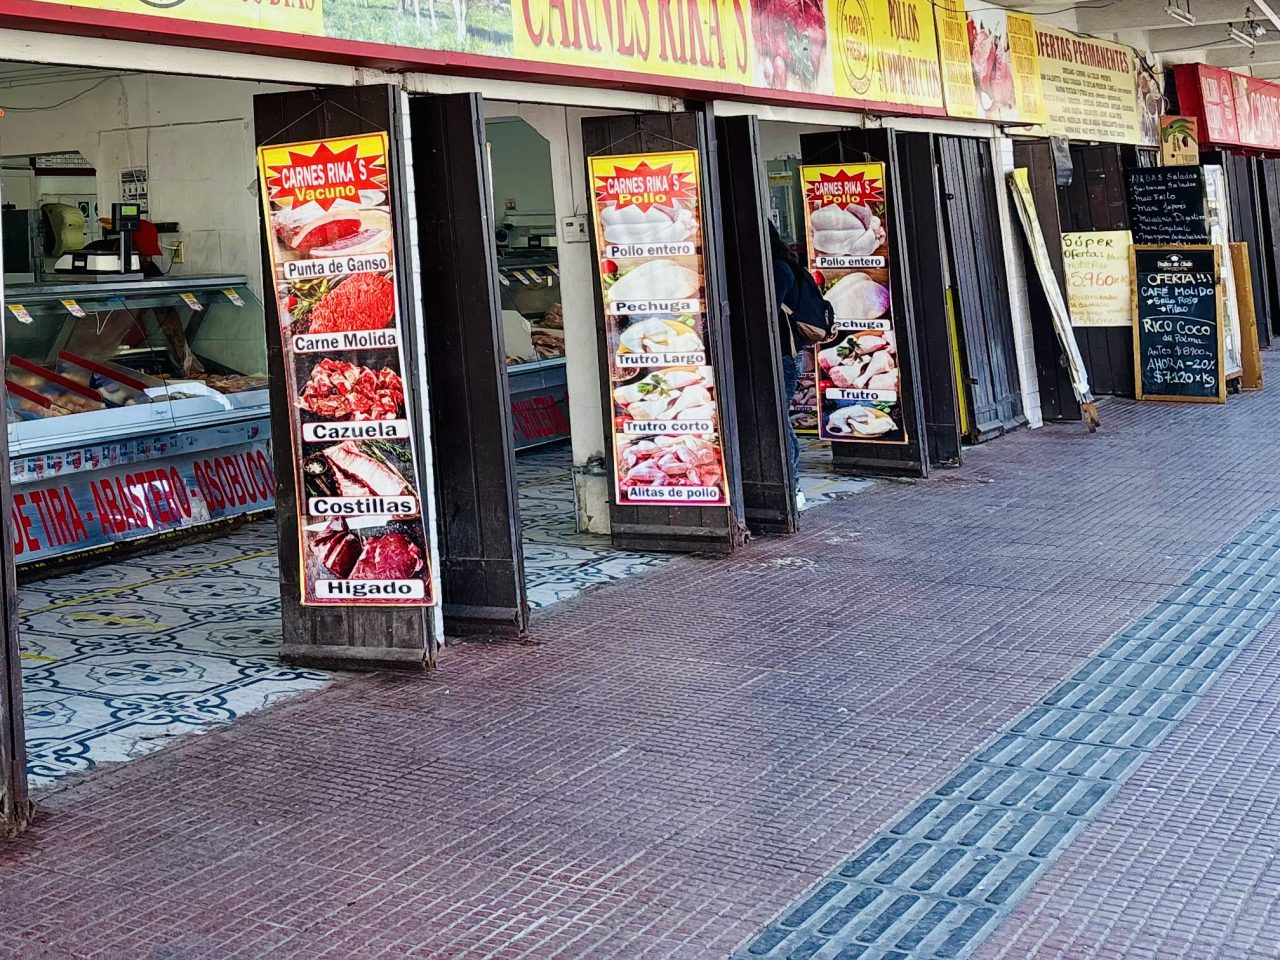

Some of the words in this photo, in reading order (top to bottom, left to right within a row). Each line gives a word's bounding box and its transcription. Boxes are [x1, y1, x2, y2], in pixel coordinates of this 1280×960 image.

[281, 163, 325, 190] CARNES
[606, 176, 645, 194] CARNES
[814, 181, 844, 195] CARNES
[294, 184, 356, 202] Vacuno
[618, 192, 667, 205] Pollo
[823, 195, 861, 204] Pollo
[1062, 234, 1113, 248] Súper
[611, 246, 644, 258] Pollo
[647, 243, 691, 256] entero
[1063, 249, 1104, 260] Oferta:
[287, 261, 325, 278] Punta
[328, 259, 344, 274] de
[346, 256, 388, 272] Ganso
[820, 257, 846, 266] Pollo
[847, 256, 882, 266] entero
[616, 301, 691, 313] Pechuga
[835, 320, 884, 329] echuga
[1142, 318, 1173, 334] RICO
[294, 334, 339, 352] Carne
[343, 331, 397, 349] Molida
[617, 354, 659, 366] Trutro
[663, 353, 705, 365] Largo
[1146, 357, 1185, 371] AHORA
[838, 389, 880, 401] Trutro
[312, 421, 398, 440] Cazuela
[625, 421, 667, 432] Trutro
[671, 421, 710, 432] corto
[28, 485, 90, 548] TIRA
[89, 465, 193, 537] ABASTERO
[192, 449, 277, 513] OSOBUCO
[630, 486, 665, 498] Alitas
[667, 487, 683, 498] de
[686, 487, 718, 500] pollo
[313, 497, 413, 515] Costillas
[327, 581, 413, 598] Higado
